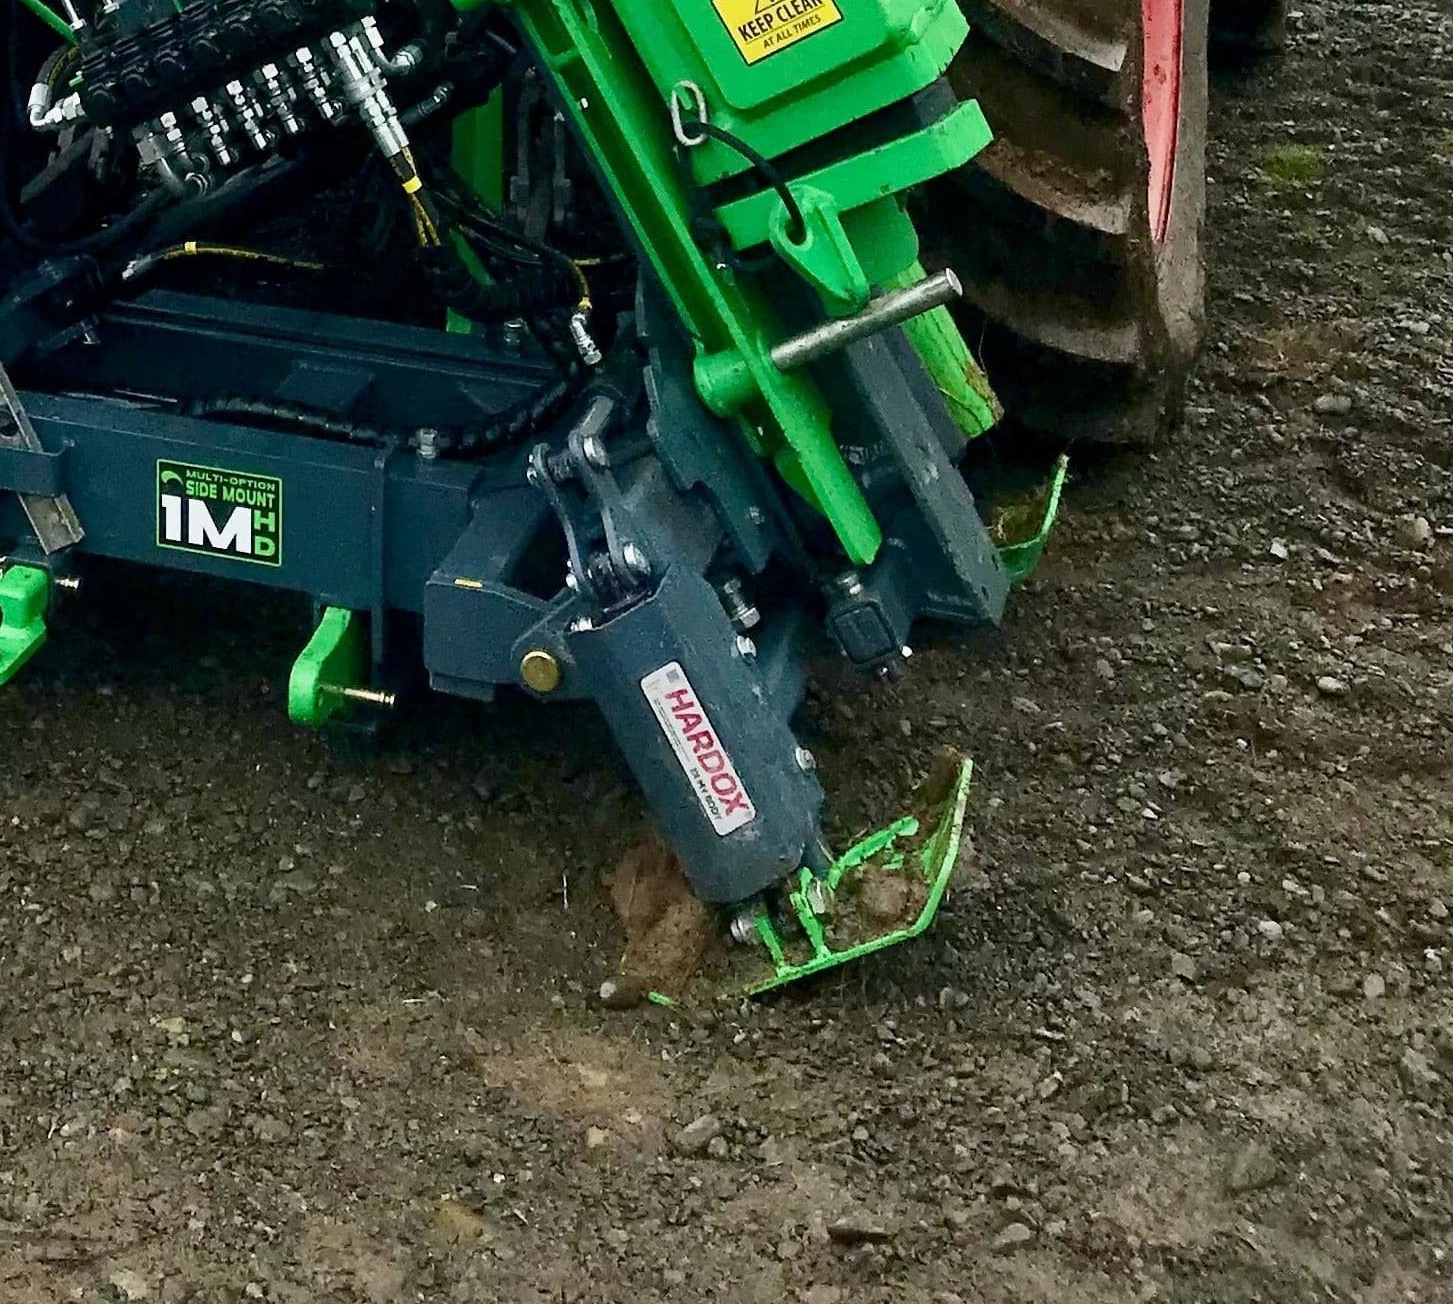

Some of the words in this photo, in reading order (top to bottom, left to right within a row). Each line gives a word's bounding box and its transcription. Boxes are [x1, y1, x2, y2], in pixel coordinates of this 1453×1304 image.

[737, 12, 774, 42] KEEP
[762, 34, 775, 49] AT
[775, 28, 793, 43] ALL
[793, 13, 822, 34] TIMES
[185, 468, 276, 492] MULTI-OPTION
[185, 479, 218, 499] SIDE
[222, 485, 276, 509] MOUNT
[161, 493, 252, 555] 1M
[664, 687, 750, 817] HARDOX
